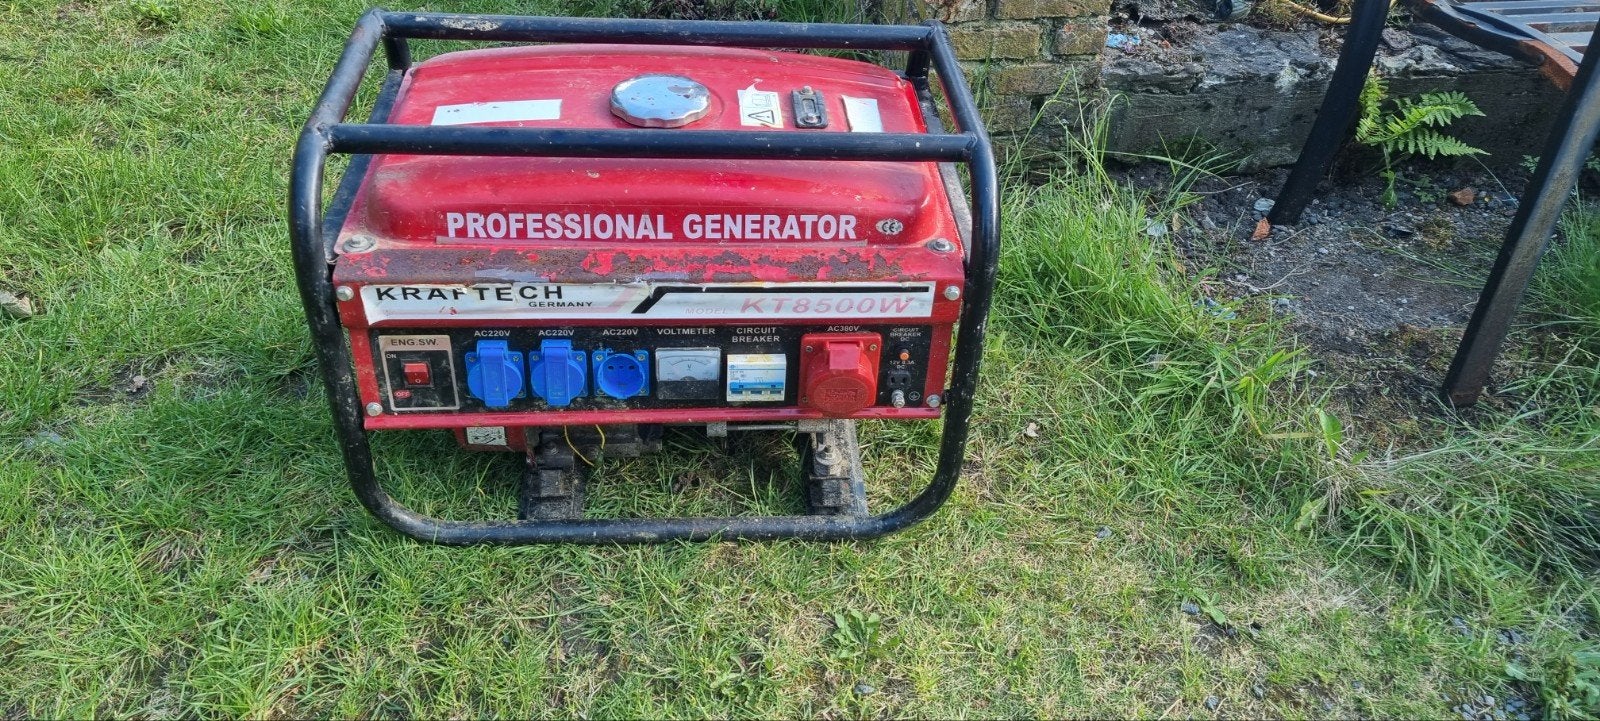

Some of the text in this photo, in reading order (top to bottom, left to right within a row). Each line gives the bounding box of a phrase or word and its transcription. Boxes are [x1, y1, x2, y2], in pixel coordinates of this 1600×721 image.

[446, 212, 857, 240] PROFESSIONAL GENERATOR
[375, 285, 563, 302] KRAFTECH
[685, 296, 915, 315] MODEL KT8500W
[538, 329, 575, 337] AC220V
[602, 328, 639, 336] AC220V
[731, 335, 780, 343] BREAKER
